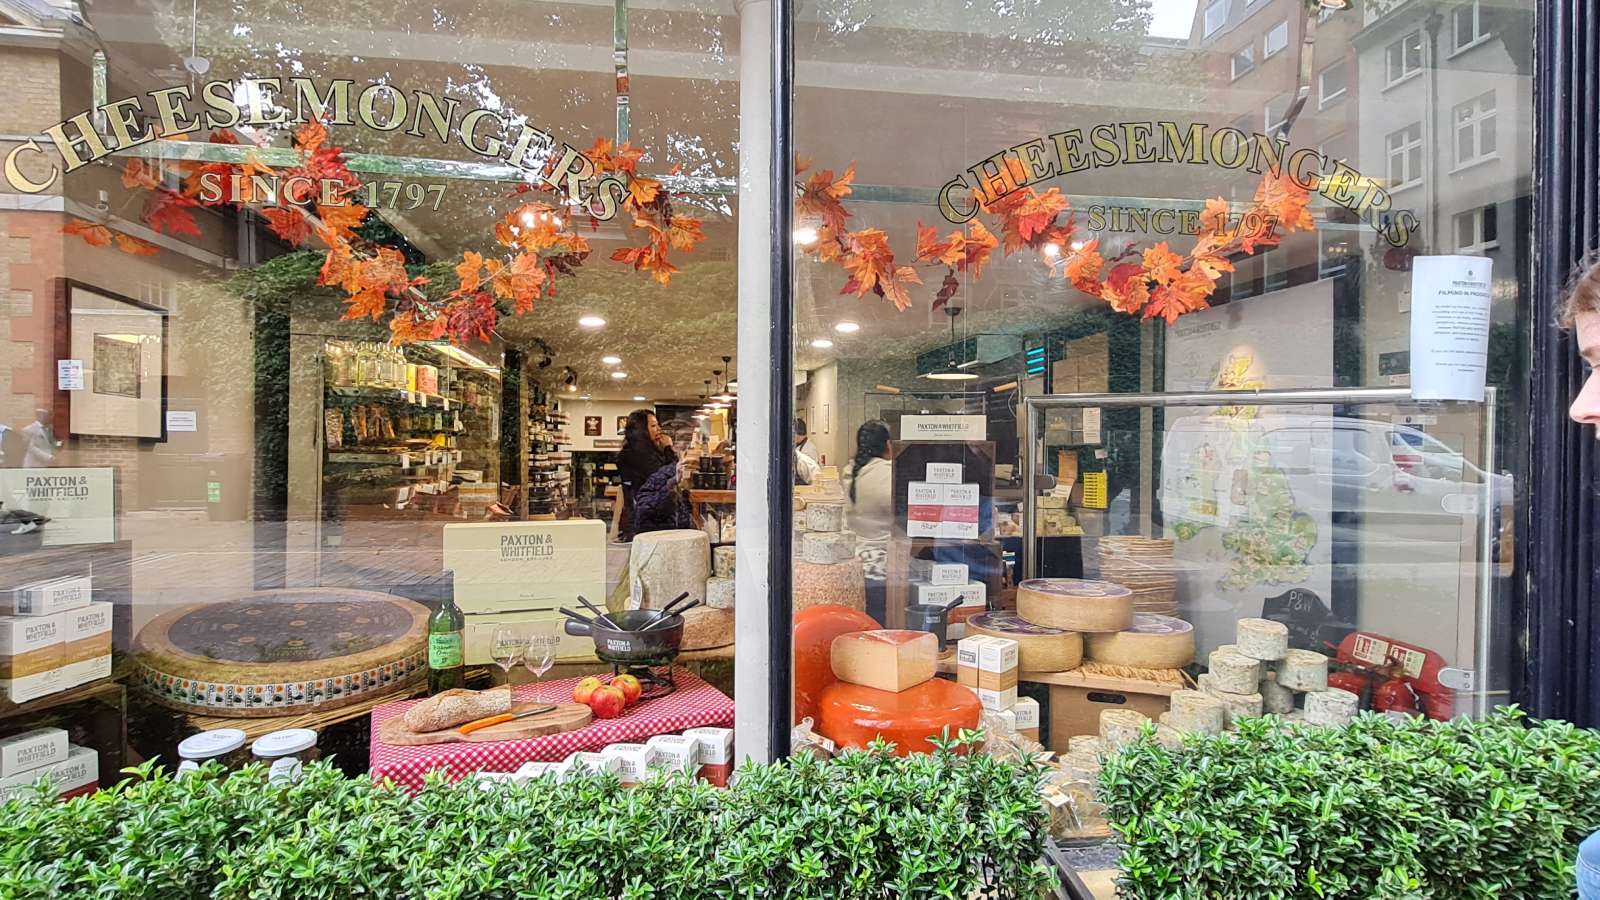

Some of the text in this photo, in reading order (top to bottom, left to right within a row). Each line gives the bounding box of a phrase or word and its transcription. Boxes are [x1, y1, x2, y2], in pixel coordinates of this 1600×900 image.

[3, 76, 631, 222] CHEESEMONGERS
[199, 173, 447, 212] SINCE 1797
[937, 120, 1420, 249] CHEESEMONGERS
[1086, 204, 1280, 241] SINCE 1797
[26, 475, 88, 487] PAXTON &
[26, 486, 89, 498] WHITFIELD
[500, 545, 554, 557] WHITFIELD
[501, 533, 553, 546] PAXTON &
